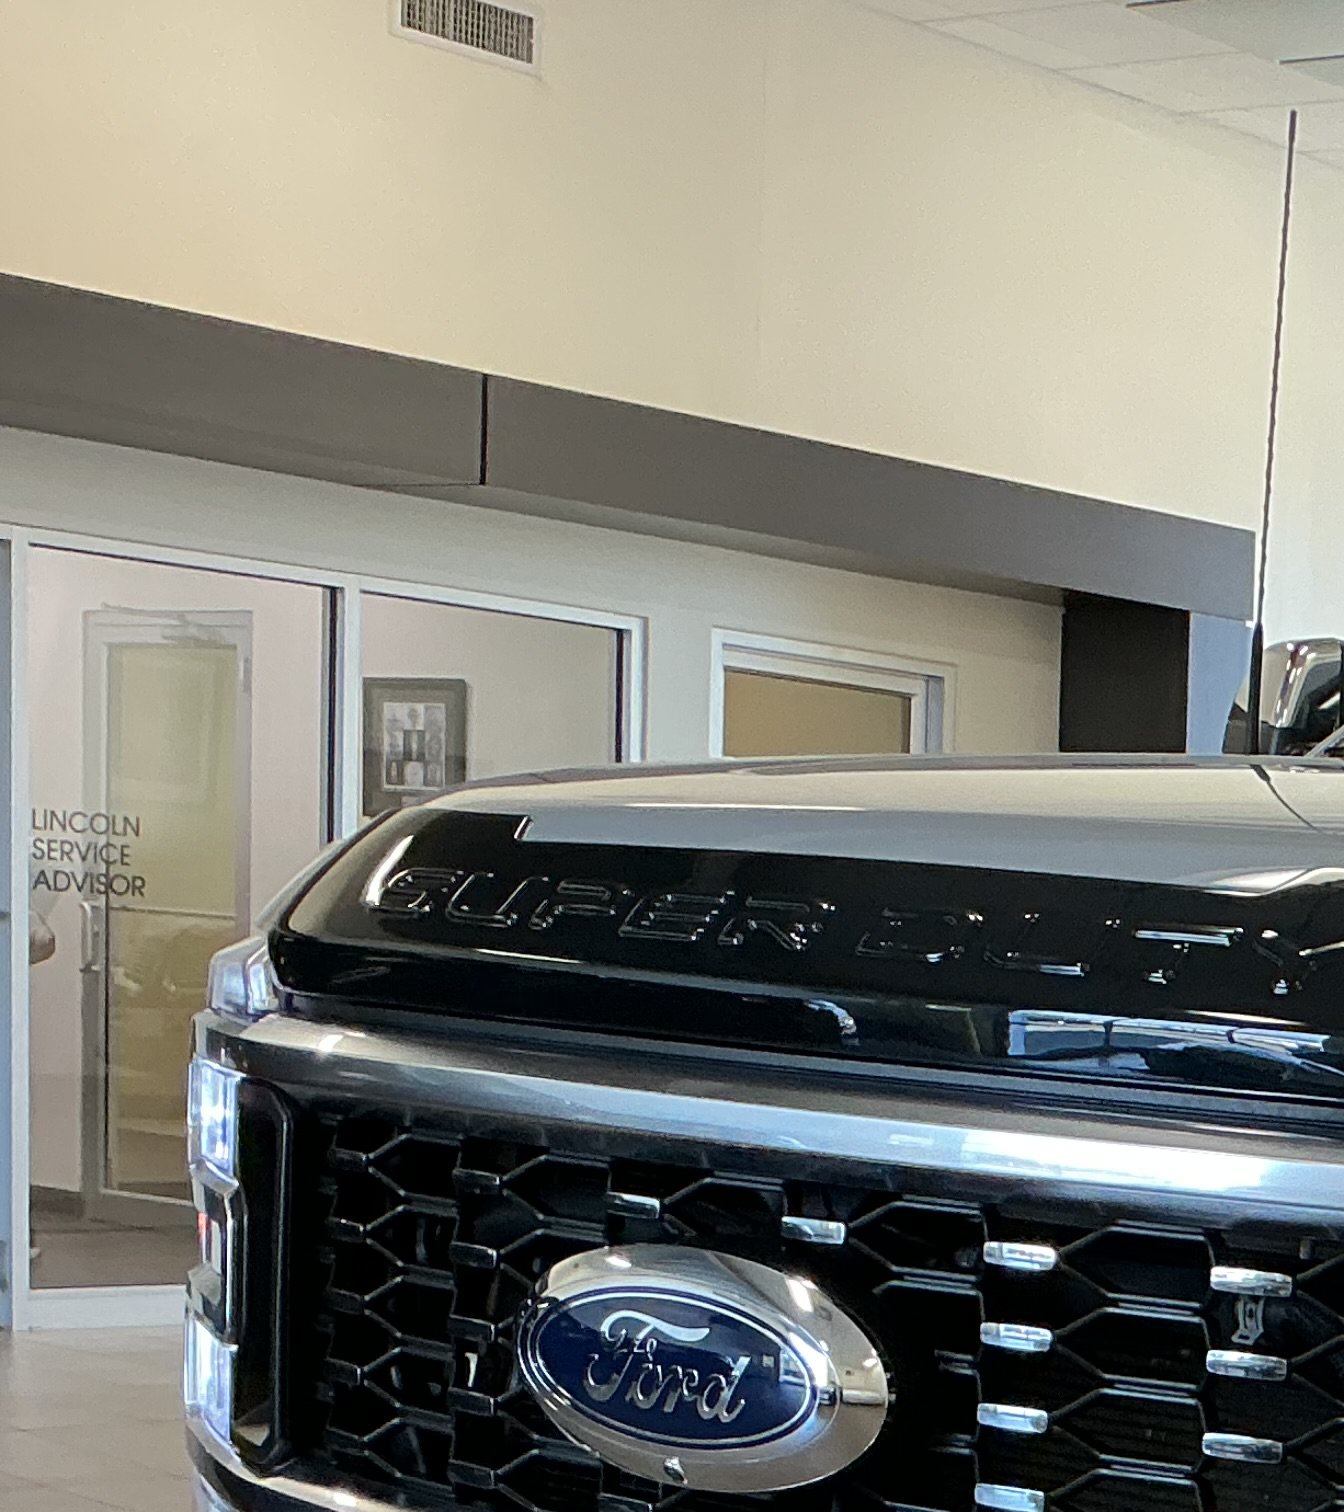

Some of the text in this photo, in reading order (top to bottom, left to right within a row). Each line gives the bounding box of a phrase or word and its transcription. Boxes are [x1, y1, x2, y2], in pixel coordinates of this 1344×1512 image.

[31, 808, 141, 837] LINCOLN
[31, 838, 131, 866] SERVICE
[32, 869, 146, 898] ADVISOR
[370, 868, 835, 951] SUPER
[582, 1309, 751, 1424] Ford
